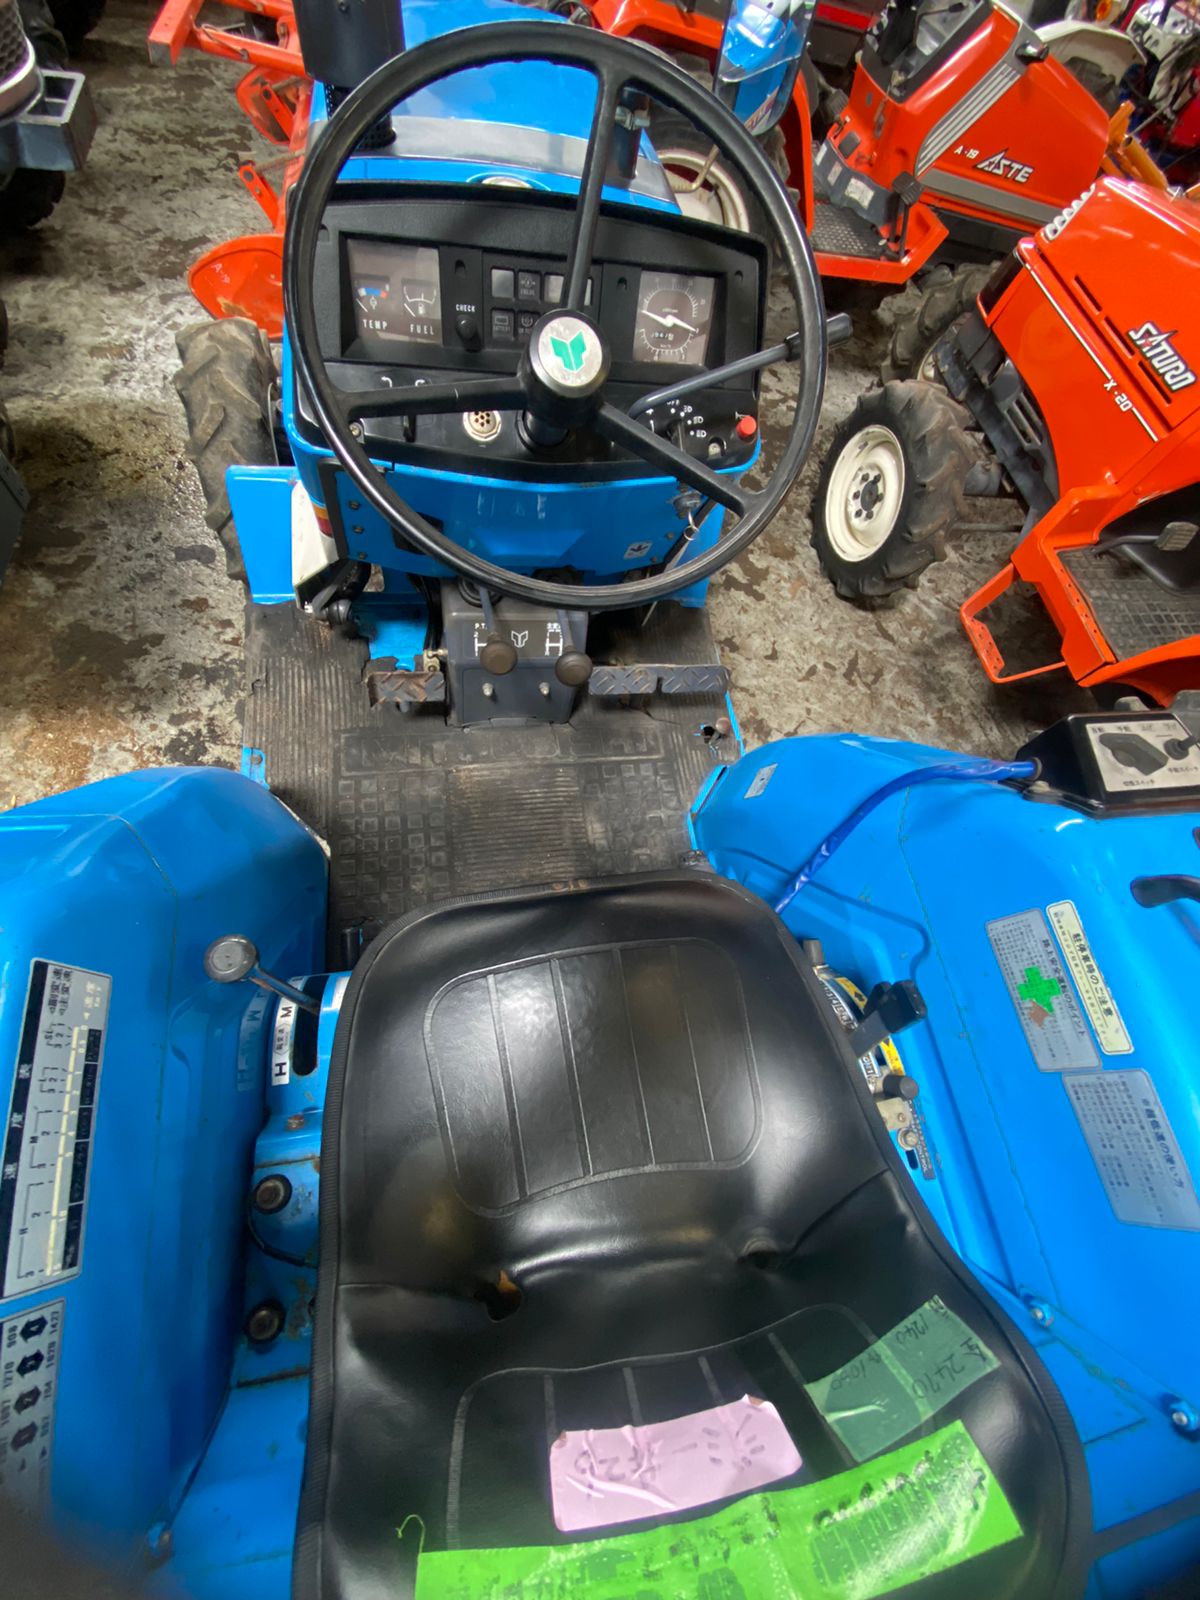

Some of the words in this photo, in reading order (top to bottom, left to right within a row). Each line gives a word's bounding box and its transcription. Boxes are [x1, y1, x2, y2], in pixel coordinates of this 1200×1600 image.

[975, 149, 1034, 183] ASTE
[455, 303, 475, 312] CHECK
[362, 319, 388, 330] TEMP
[409, 323, 434, 335] FUEL
[1128, 321, 1197, 391] SATURN
[1072, 932, 1114, 1017] 駐停車時のご注意
[281, 1006, 292, 1018] M
[274, 1062, 287, 1077] H
[896, 1314, 930, 1346] 1240
[912, 1353, 966, 1400] 2470
